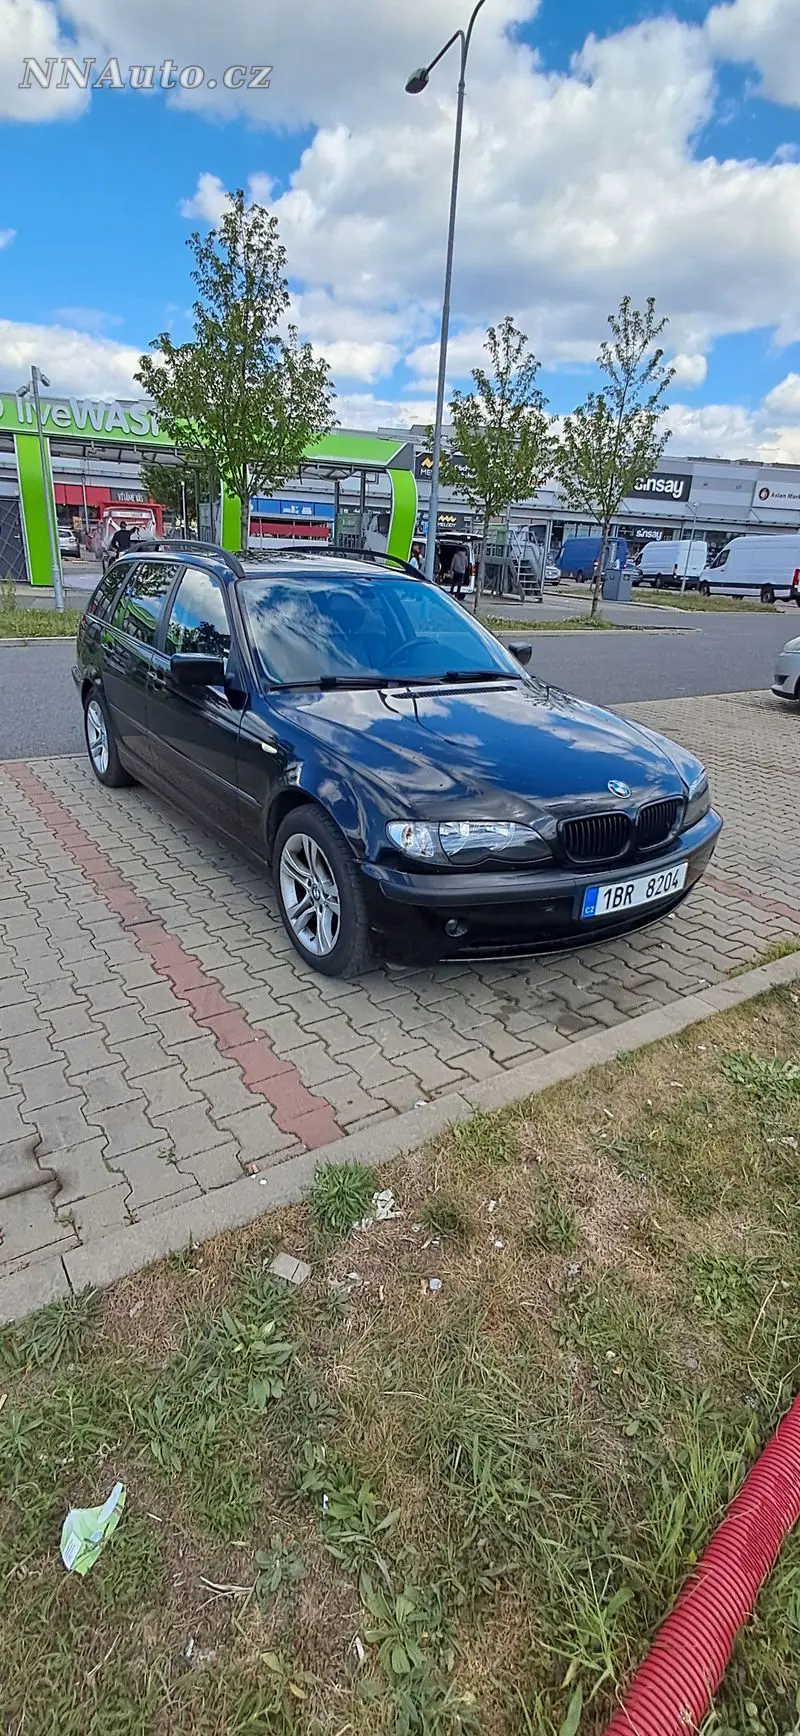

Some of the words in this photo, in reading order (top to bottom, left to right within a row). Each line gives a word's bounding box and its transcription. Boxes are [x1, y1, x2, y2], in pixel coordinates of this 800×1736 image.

[603, 884, 635, 910] 1BR
[646, 868, 680, 899] 8204
[584, 905, 595, 914] CZ
